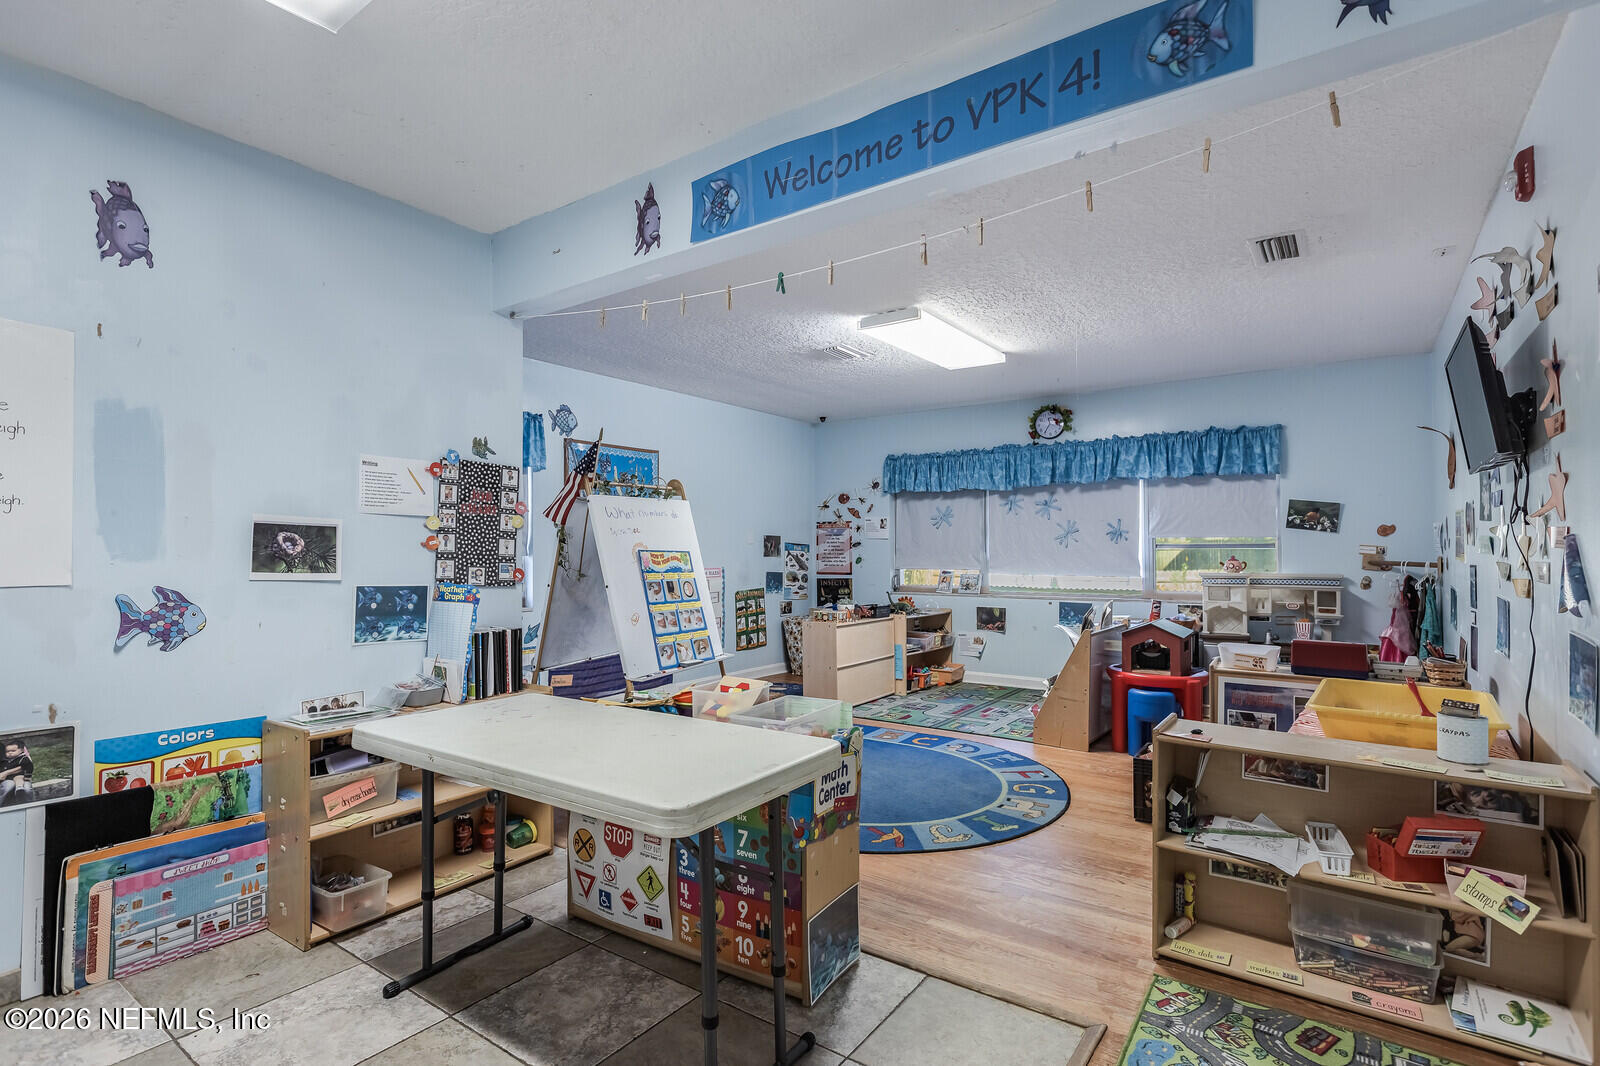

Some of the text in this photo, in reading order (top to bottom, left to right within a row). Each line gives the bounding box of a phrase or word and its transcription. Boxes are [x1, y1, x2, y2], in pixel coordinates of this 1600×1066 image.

[764, 48, 1102, 200] Welcome to VPK 4!
[604, 506, 635, 520] What
[439, 583, 468, 595] Weather
[821, 579, 847, 587] INSECTS
[444, 592, 465, 603] Graph
[157, 728, 215, 746] Colors
[1438, 727, 1471, 738] RAYPAS
[818, 778, 852, 807] Center
[736, 812, 748, 822] six
[604, 824, 633, 847] STOP
[737, 828, 749, 848] 7
[679, 849, 689, 867] 3
[736, 849, 758, 861] seven
[678, 865, 696, 878] three
[680, 881, 690, 901] 4
[736, 883, 756, 897] eight
[1462, 881, 1498, 910] stamps
[679, 897, 693, 910] four
[737, 900, 749, 919] 9
[681, 914, 690, 934] 5
[736, 918, 752, 930] nine
[680, 930, 693, 943] five
[735, 935, 754, 957] 10
[1173, 943, 1195, 955] bingo
[737, 953, 750, 966] ten
[1375, 1000, 1418, 1017] crayons
